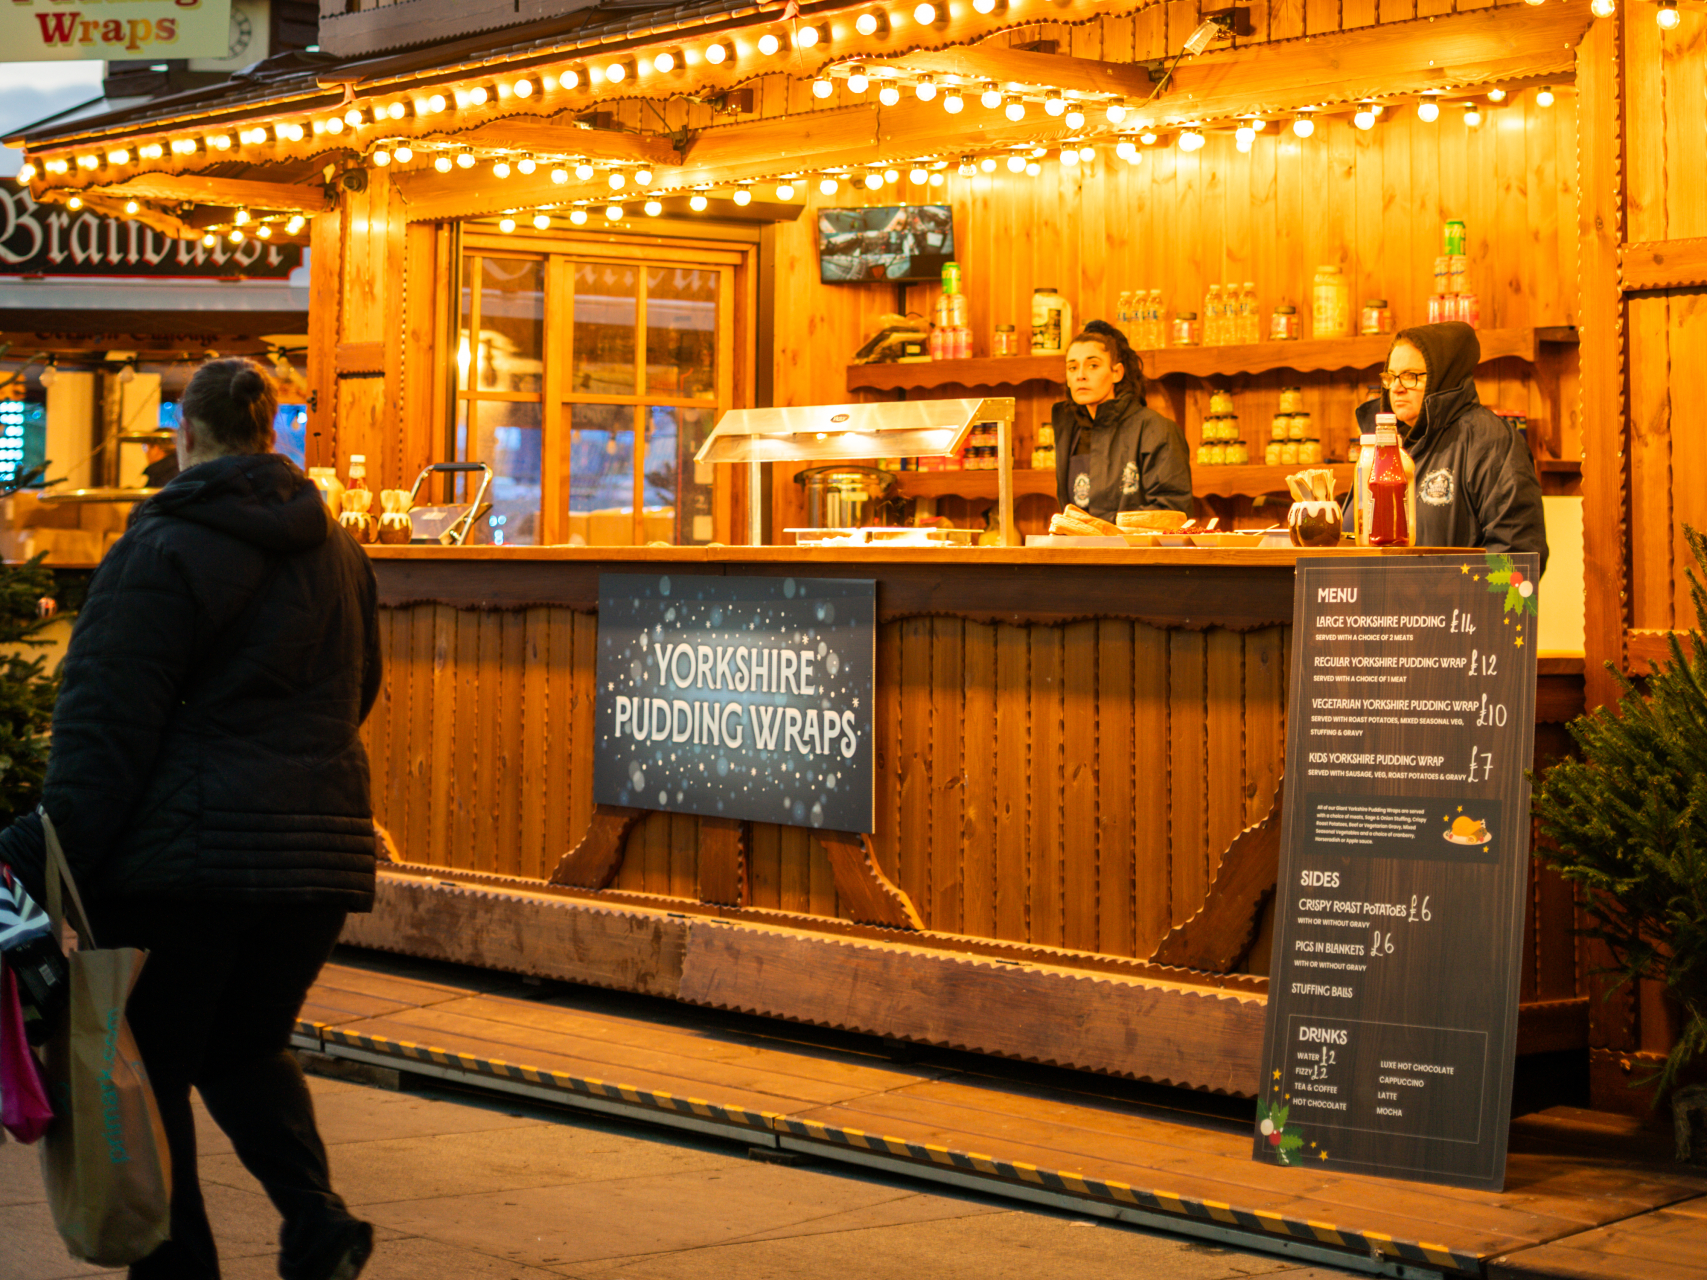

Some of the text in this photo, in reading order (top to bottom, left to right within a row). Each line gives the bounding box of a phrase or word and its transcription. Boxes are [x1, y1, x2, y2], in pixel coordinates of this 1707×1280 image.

[35, 12, 177, 51] Wraps
[1318, 588, 1357, 603] MENU
[1316, 609, 1476, 635] LARGE YORKSHIRE PUDDING £14
[654, 643, 816, 695] YORKSHIRE
[1314, 649, 1497, 676] REGULAR YORKSHIRE PUDDING WRAP £12
[1312, 693, 1507, 727] VEGETARIAN YORKSHIRE PUDDING WRAP £10
[615, 695, 857, 758] PUDDING WRAPS
[1309, 745, 1493, 782] KIDS YORKSHIRE PUDDING WRAP £7
[1409, 772, 1439, 780] POTATOES
[1301, 870, 1340, 888] SIDES
[1299, 895, 1431, 922] CRISPY ROAST POTATOES £6
[1322, 919, 1349, 927] WITHOUT
[1295, 930, 1394, 956] PIGS IN BLANKETS £6
[1319, 962, 1345, 970] WITHOUT
[1292, 983, 1353, 998] STUFFING BALLS
[1299, 1026, 1347, 1045] DRINKS
[1297, 1046, 1336, 1066] WATER £2
[1296, 1065, 1328, 1080] FIZZY £2
[1381, 1061, 1454, 1075] LUXE HOT CHOCOLATE
[97, 1008, 131, 1163] primark.com
[1314, 1085, 1337, 1094] COFFEE
[1379, 1076, 1424, 1087] CAPPUCCINO
[1293, 1098, 1347, 1110] HOT CHOCOLATE
[1378, 1092, 1397, 1100] LATTE
[1377, 1107, 1402, 1117] MOCHA
